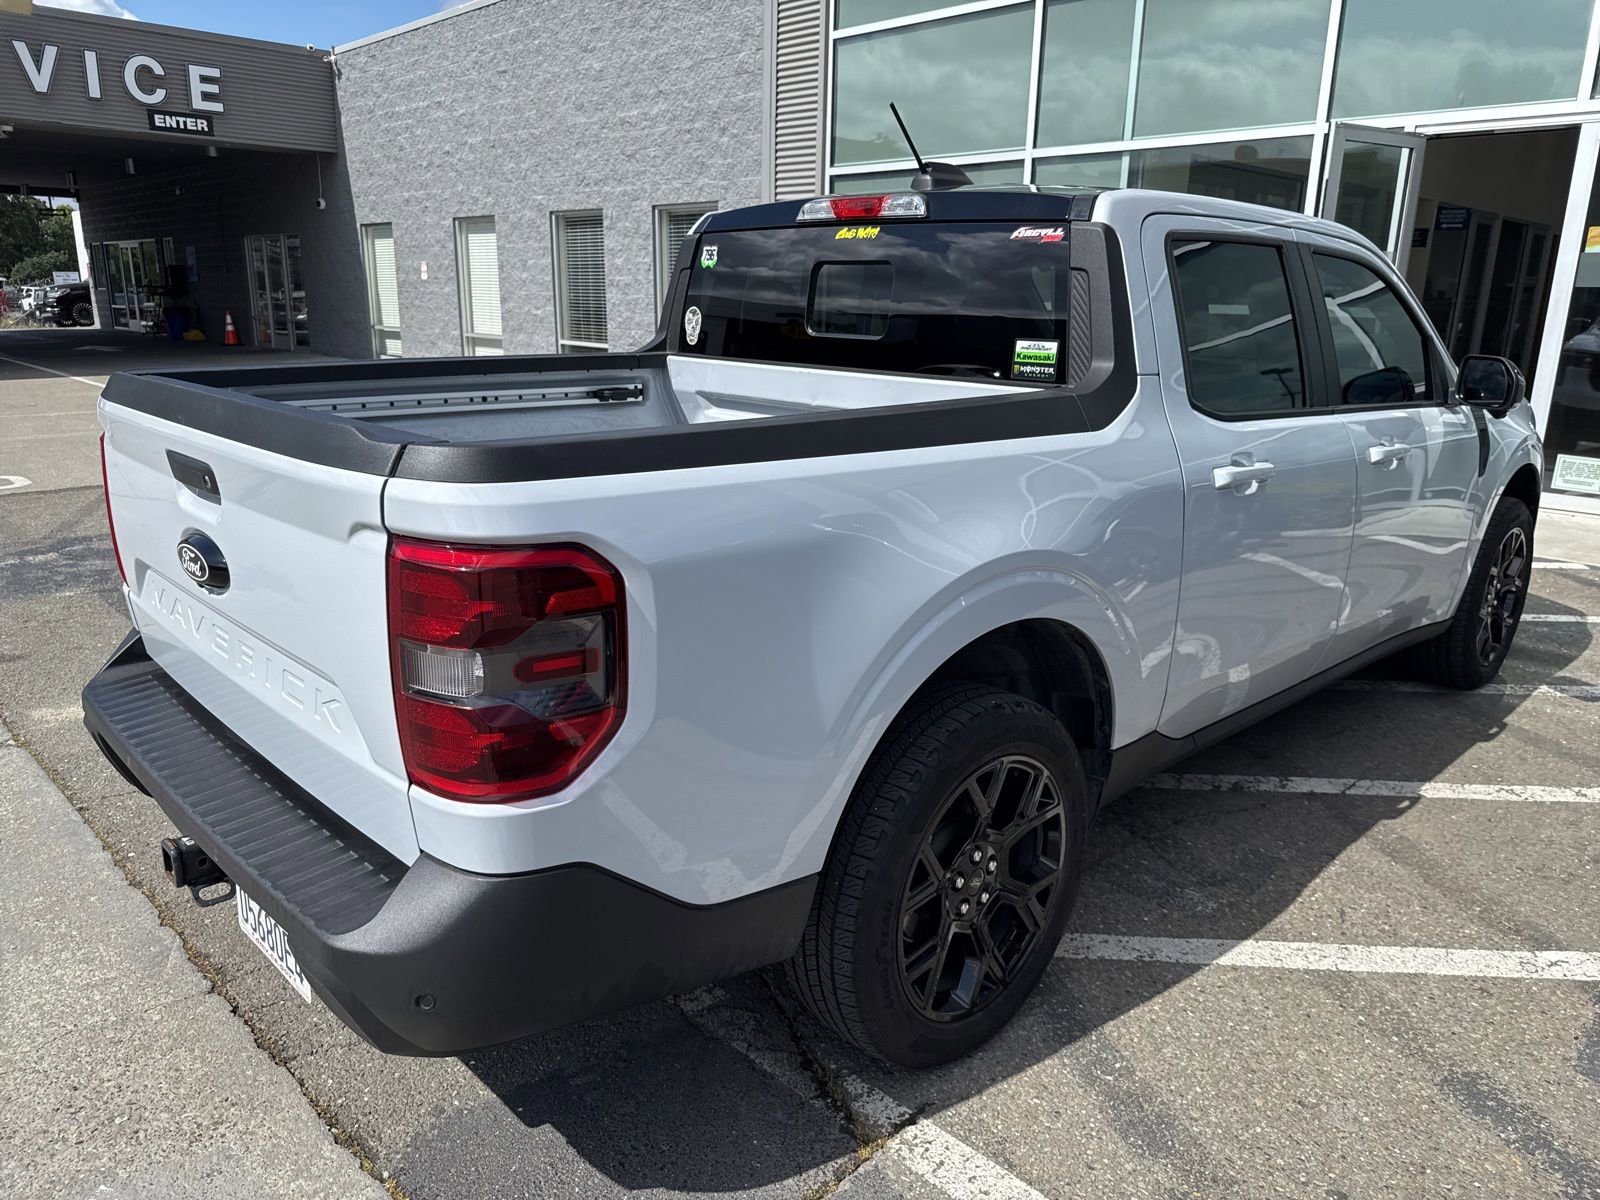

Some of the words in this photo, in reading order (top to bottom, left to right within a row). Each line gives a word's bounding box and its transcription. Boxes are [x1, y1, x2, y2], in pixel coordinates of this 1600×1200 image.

[10, 39, 225, 114] VICE
[154, 114, 209, 131] ENTER
[1016, 352, 1055, 362] Kawasaki
[1020, 365, 1054, 374] MONSTER
[182, 548, 201, 577] Ford
[152, 580, 342, 734] MAVERICK
